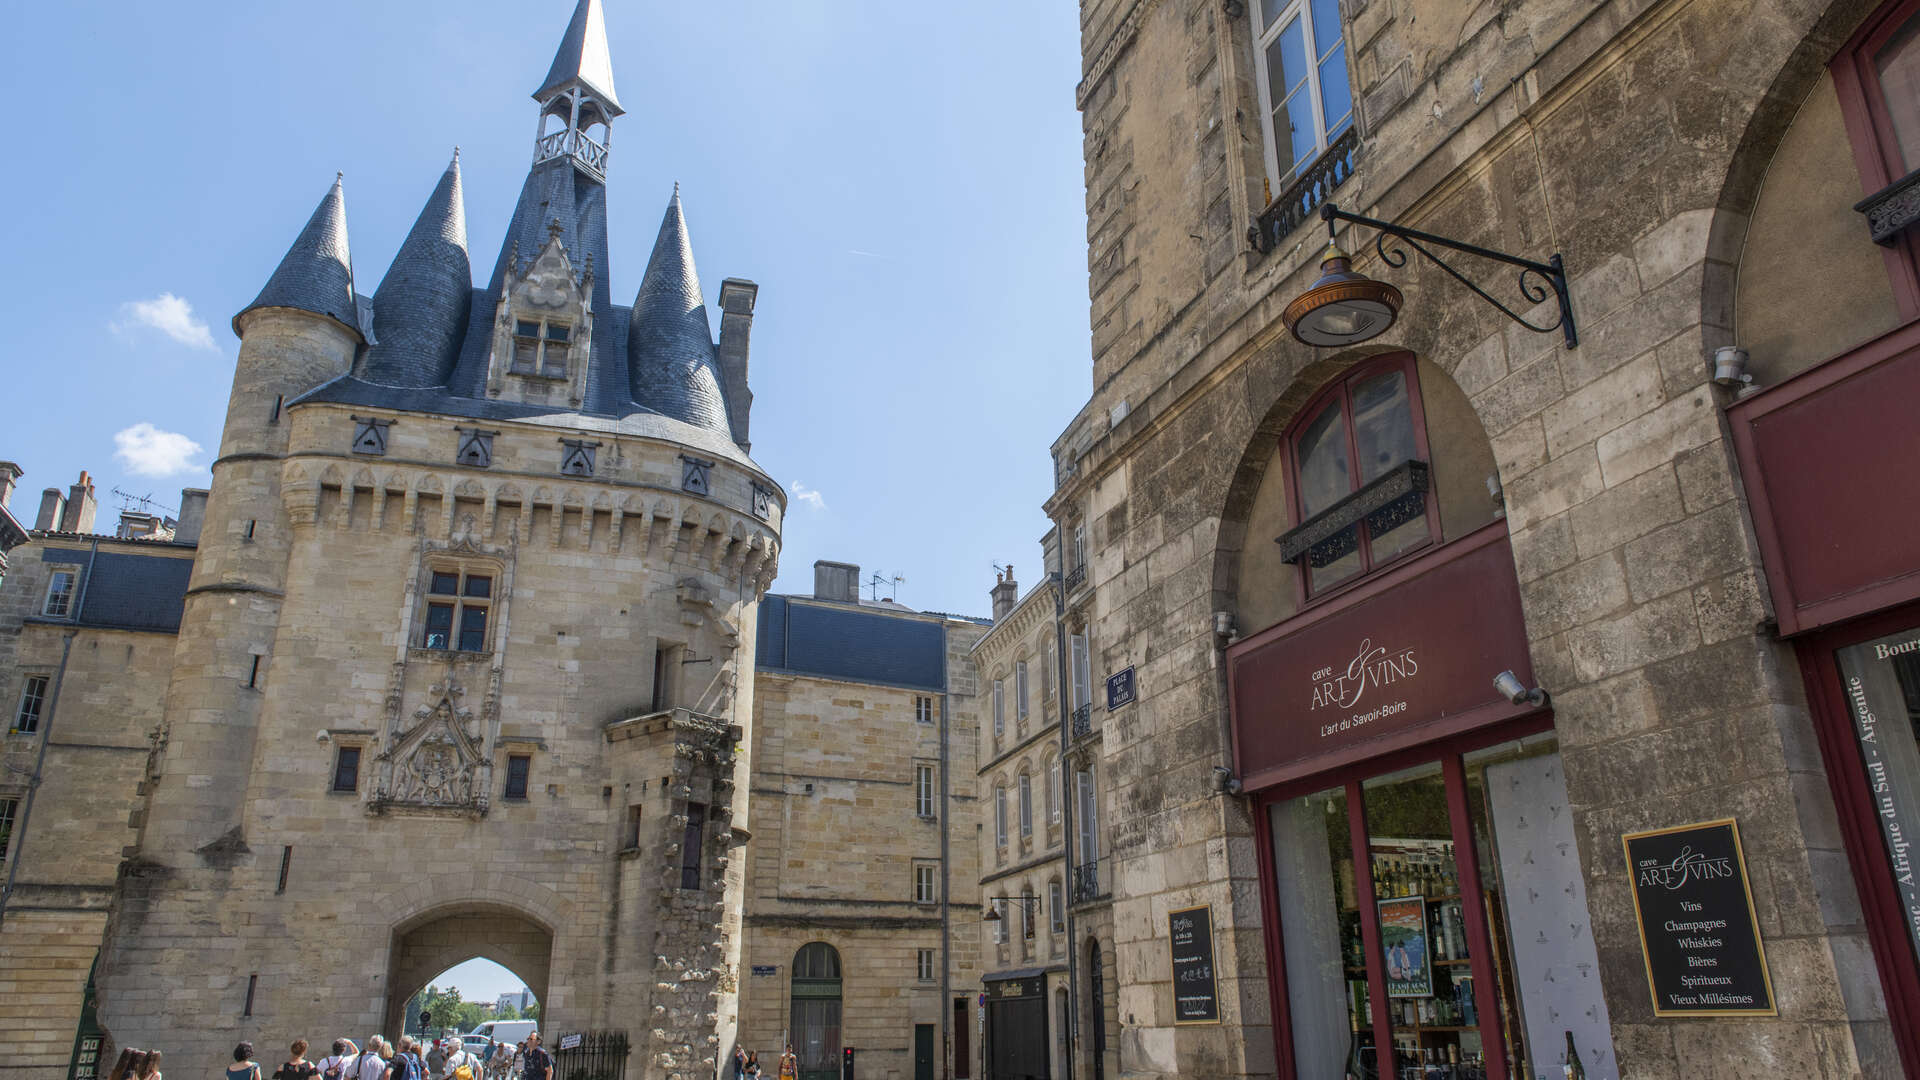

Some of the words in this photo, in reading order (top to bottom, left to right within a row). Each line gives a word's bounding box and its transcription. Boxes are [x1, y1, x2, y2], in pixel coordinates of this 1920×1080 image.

[1113, 673, 1127, 687] PLACE
[1311, 666, 1332, 681] cave
[1311, 676, 1348, 711] ART
[1367, 651, 1418, 688] VINS
[1117, 684, 1124, 694] DU
[1113, 691, 1129, 704] PALAIS
[1321, 722, 1338, 737] L'art
[1340, 719, 1351, 731] du
[1352, 701, 1407, 727] Savoir-Boire
[1868, 761, 1889, 793] Sud
[1880, 796, 1896, 819] du
[1889, 822, 1915, 887] Afrique
[1639, 858, 1657, 868] cave
[1640, 867, 1672, 887] ART
[1690, 860, 1733, 879] VINS
[1680, 901, 1703, 912] Vins
[1664, 919, 1727, 933] Champagnes
[1678, 937, 1722, 949] Whiskies
[1688, 956, 1718, 967] Bières
[1681, 975, 1732, 989] Spiritueux
[1670, 994, 1697, 1005] Vieux
[1699, 992, 1753, 1004] Millésimes
